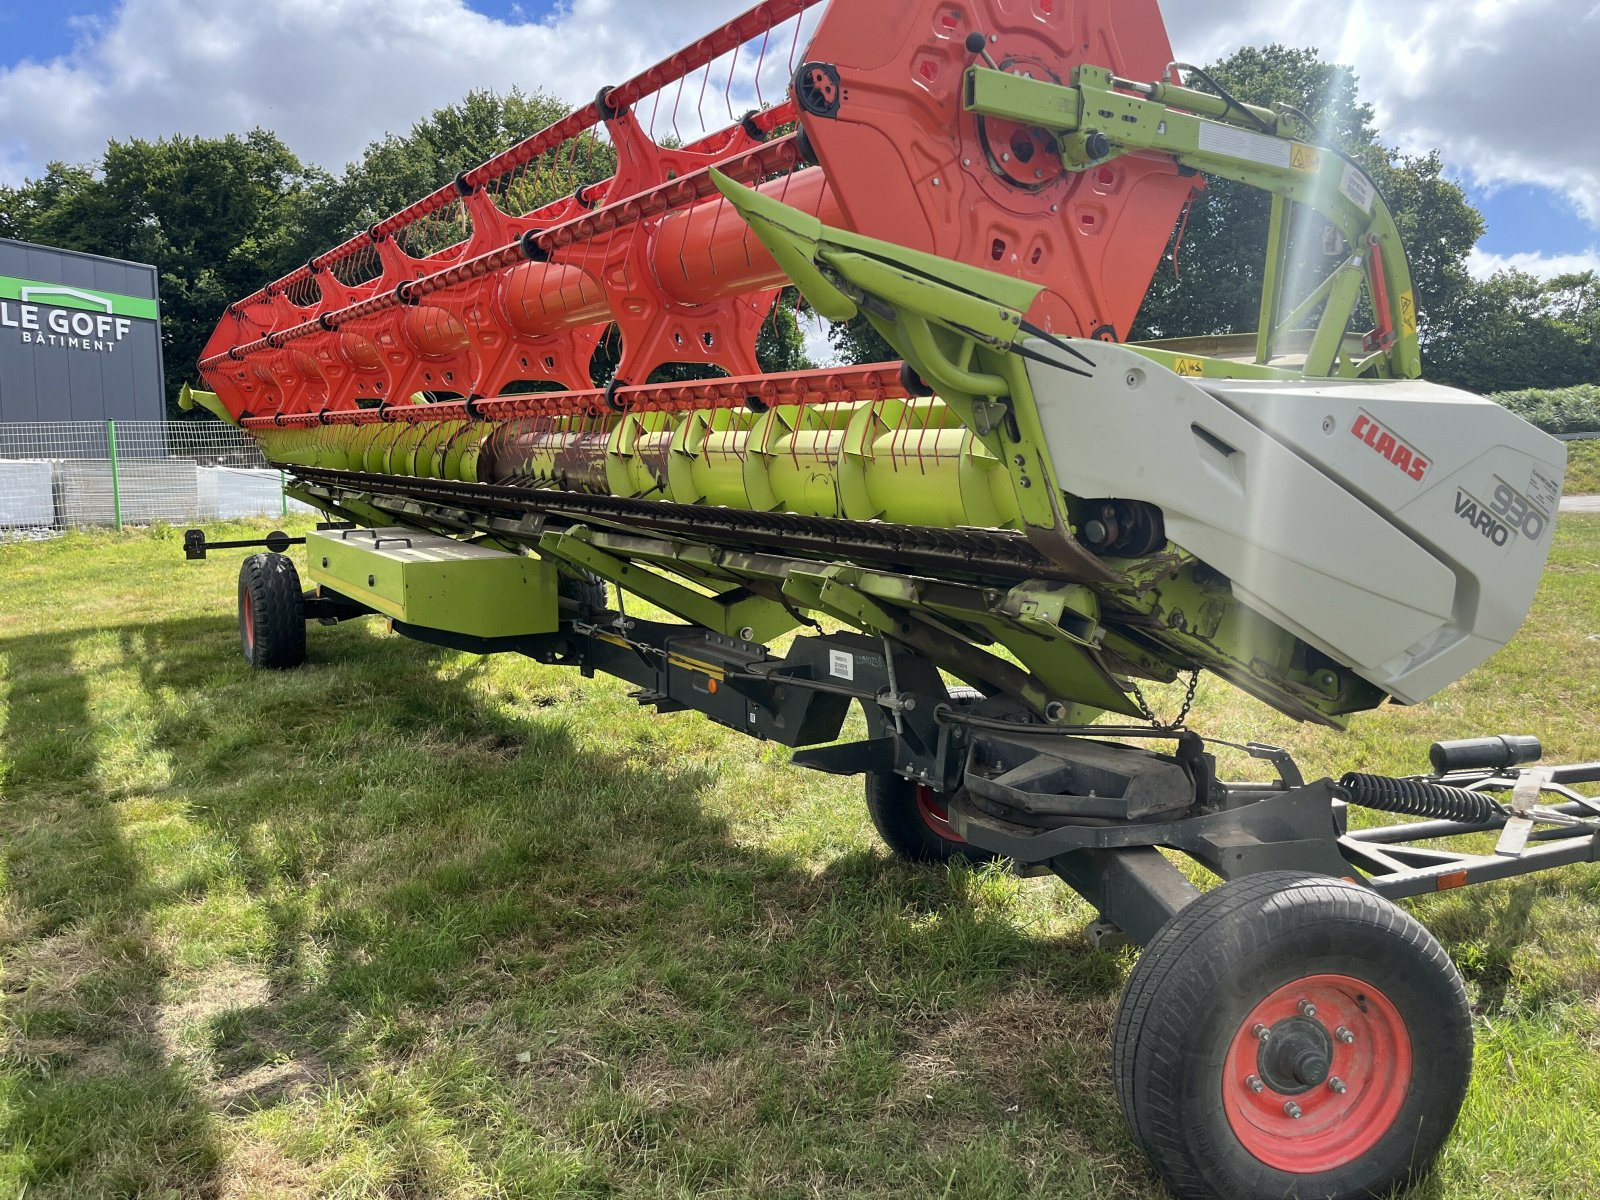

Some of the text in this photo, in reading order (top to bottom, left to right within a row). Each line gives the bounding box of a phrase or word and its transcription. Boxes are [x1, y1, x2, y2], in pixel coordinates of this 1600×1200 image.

[1, 302, 132, 340] LE GOFF
[22, 331, 115, 352] BÂTIMENT
[1351, 414, 1428, 482] CLAAS
[1454, 490, 1509, 547] VARIO
[1489, 484, 1544, 541] 930
